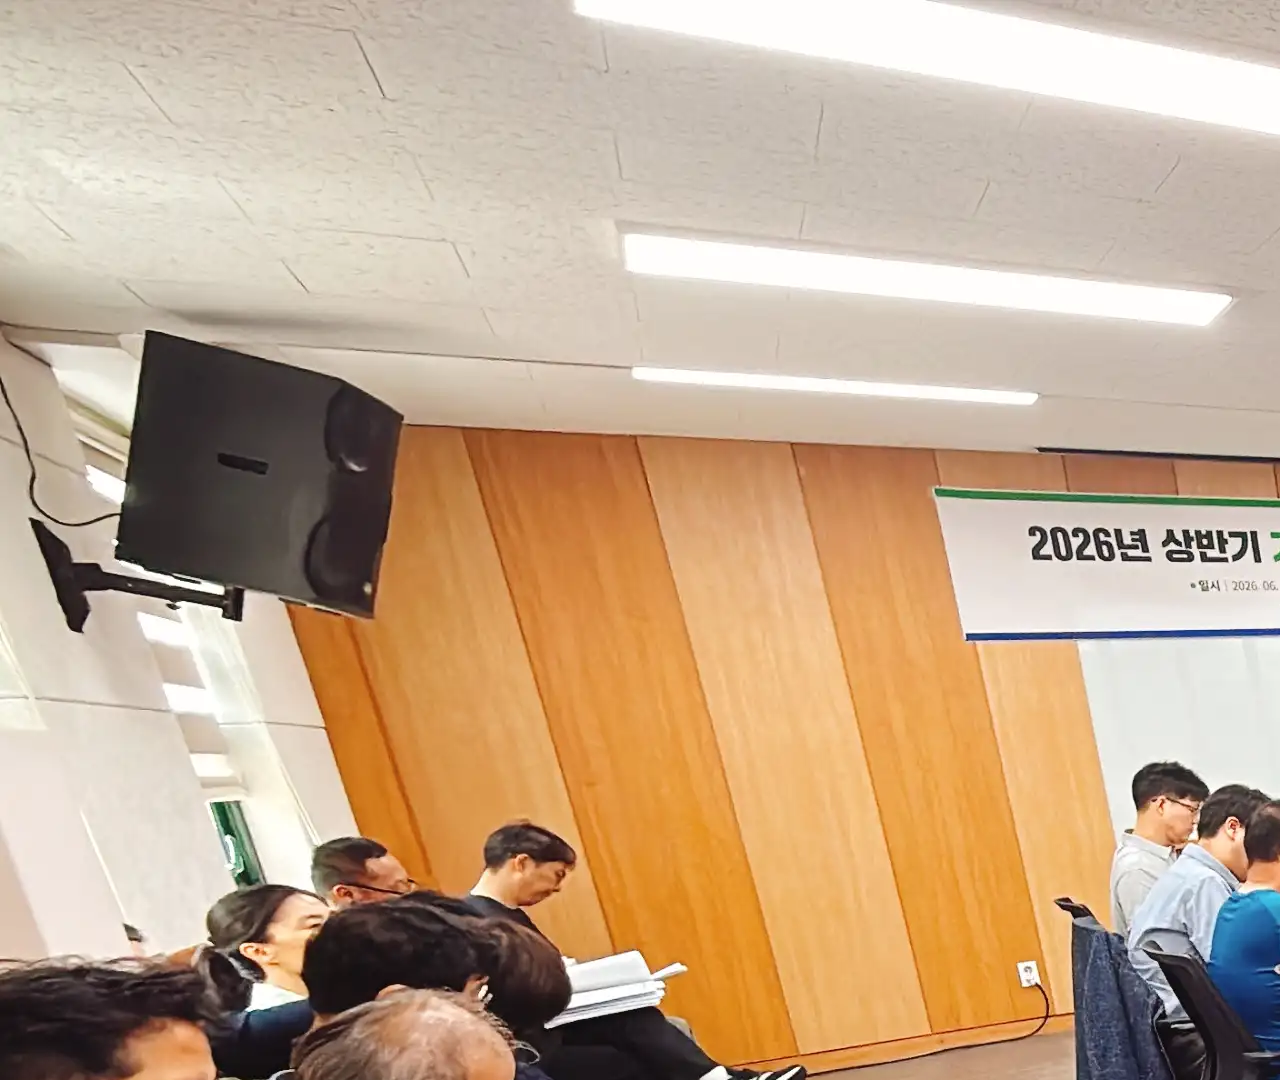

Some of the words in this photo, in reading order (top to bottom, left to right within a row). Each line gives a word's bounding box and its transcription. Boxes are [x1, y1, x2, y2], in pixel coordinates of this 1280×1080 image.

[1028, 525, 1152, 563] 2026년
[1161, 528, 1262, 564] 상반기
[1199, 580, 1221, 592] 일시
